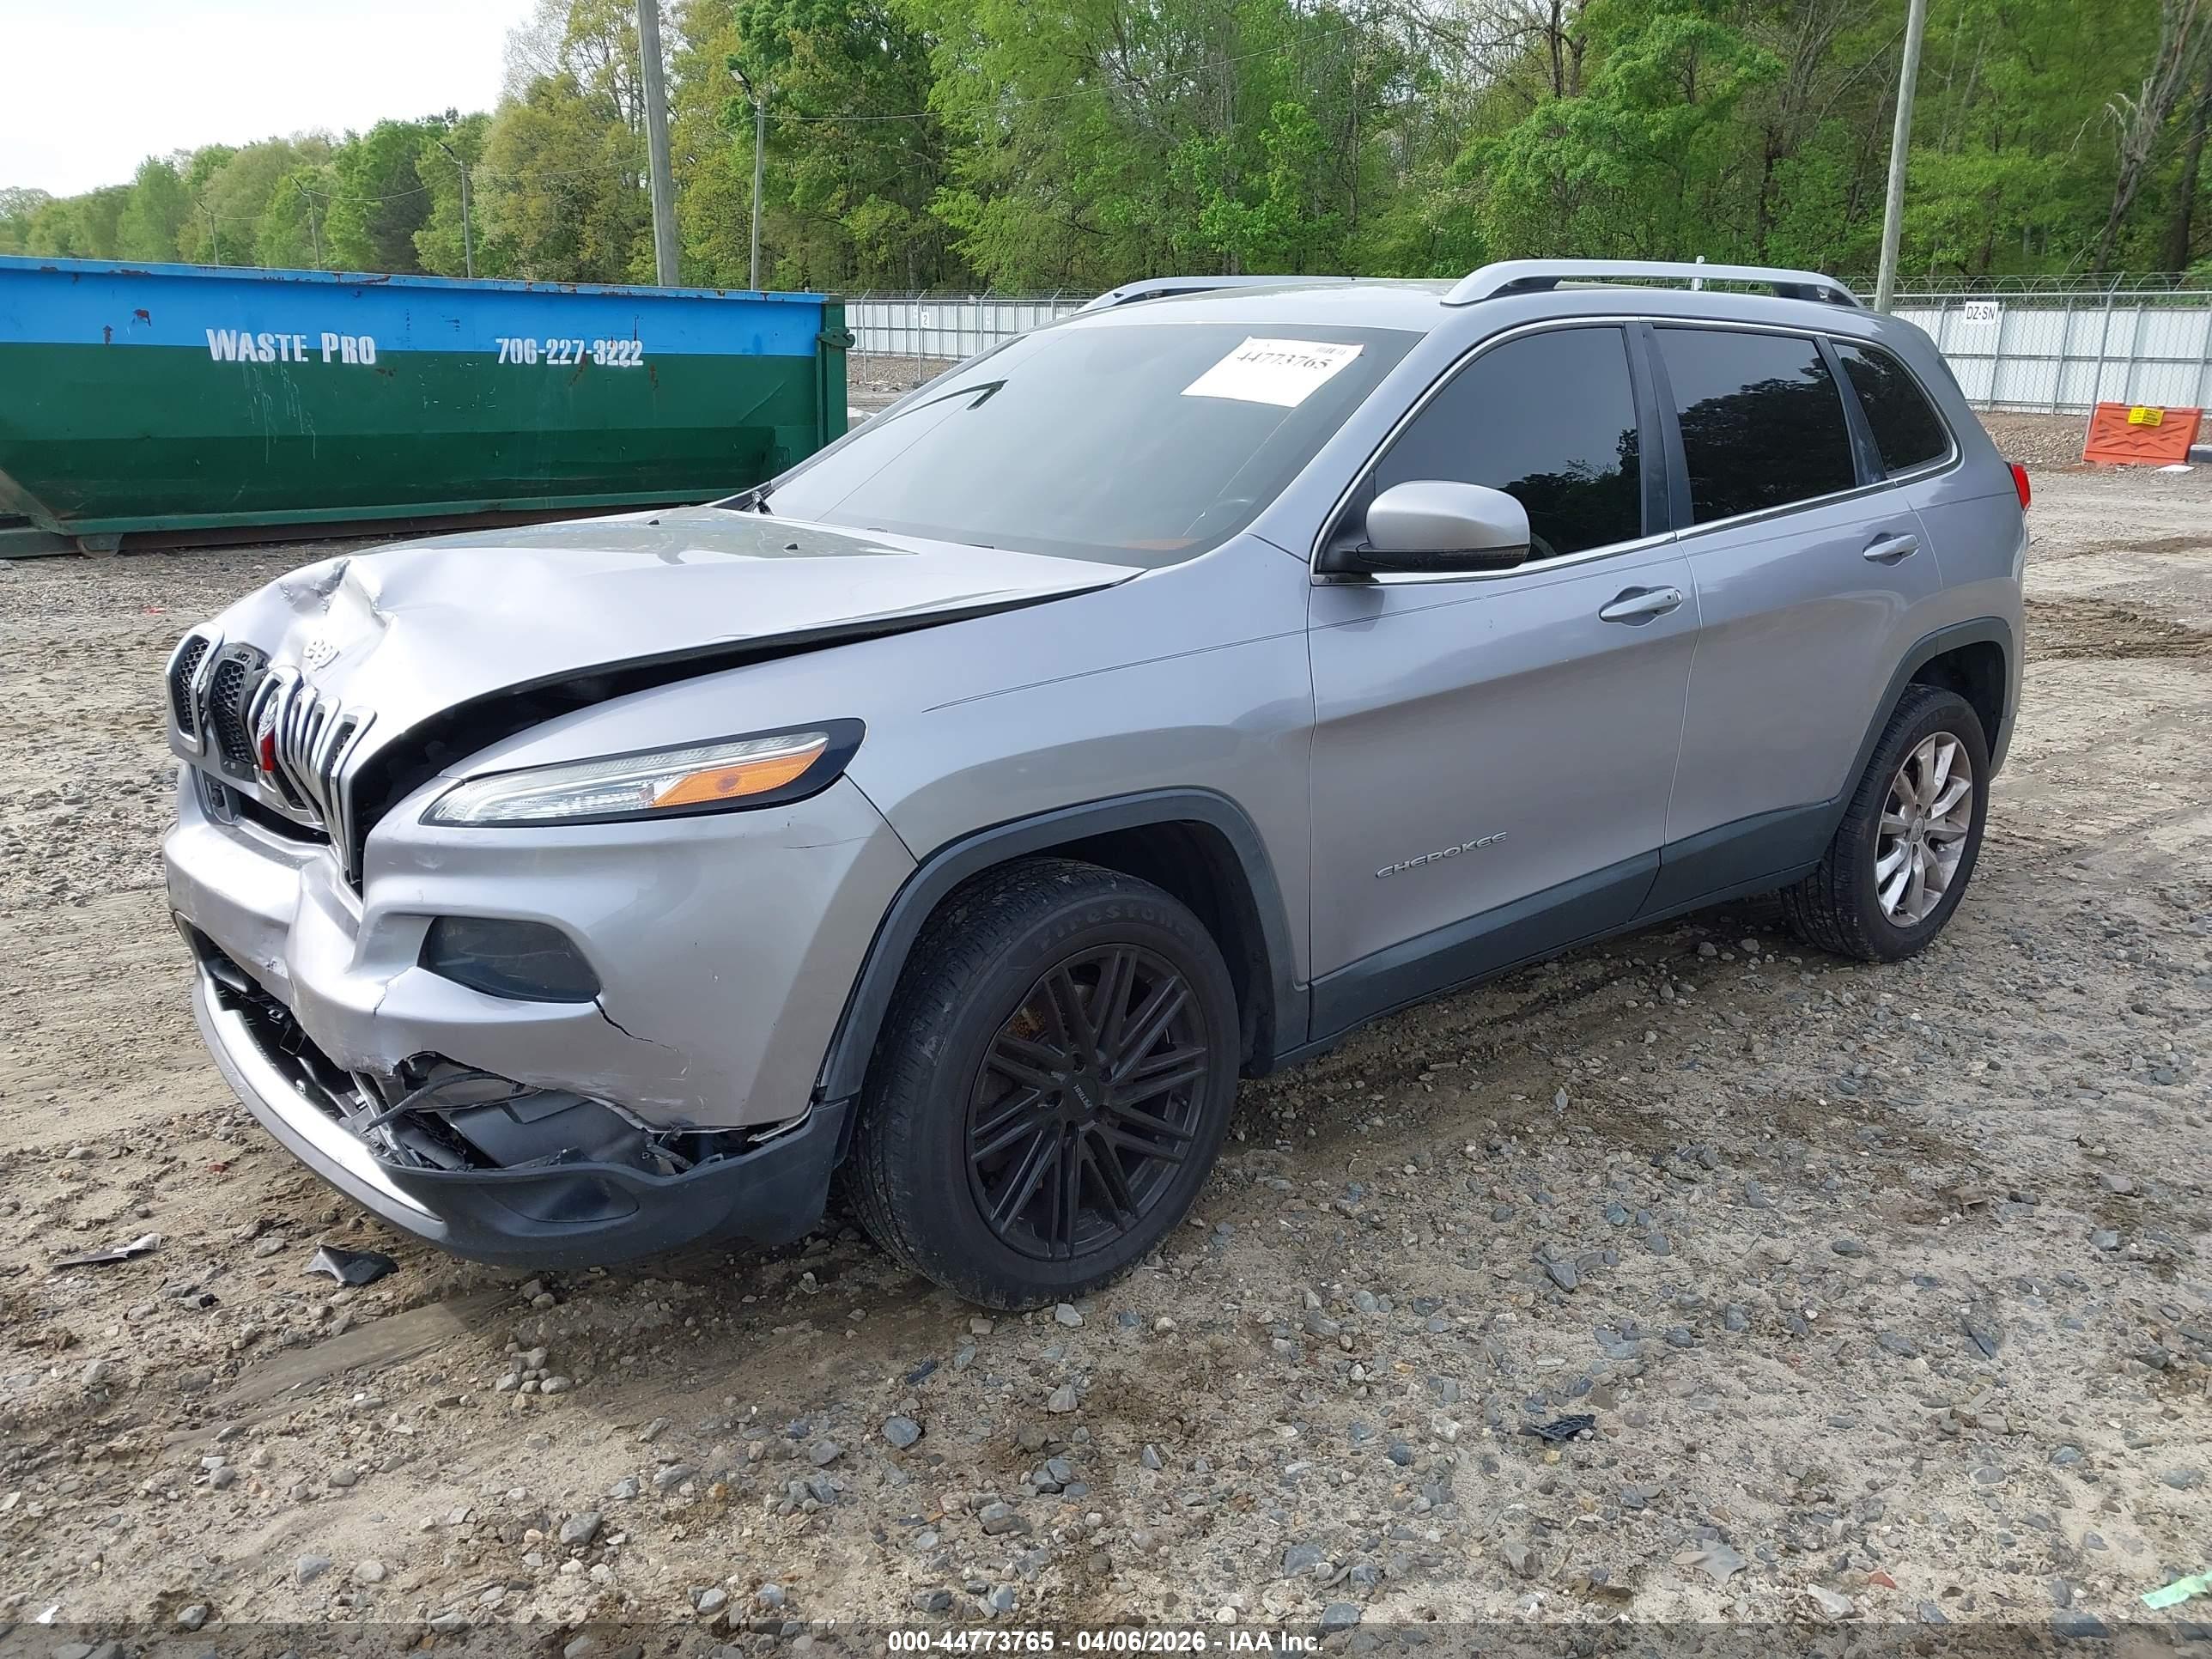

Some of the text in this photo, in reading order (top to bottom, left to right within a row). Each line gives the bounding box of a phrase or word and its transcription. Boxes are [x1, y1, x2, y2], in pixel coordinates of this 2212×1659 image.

[206, 328, 376, 364] WASTE PRO
[495, 337, 644, 367] 706-227-3222
[1237, 352, 1333, 369] 44773765
[1375, 831, 1507, 878] CHEROKEE
